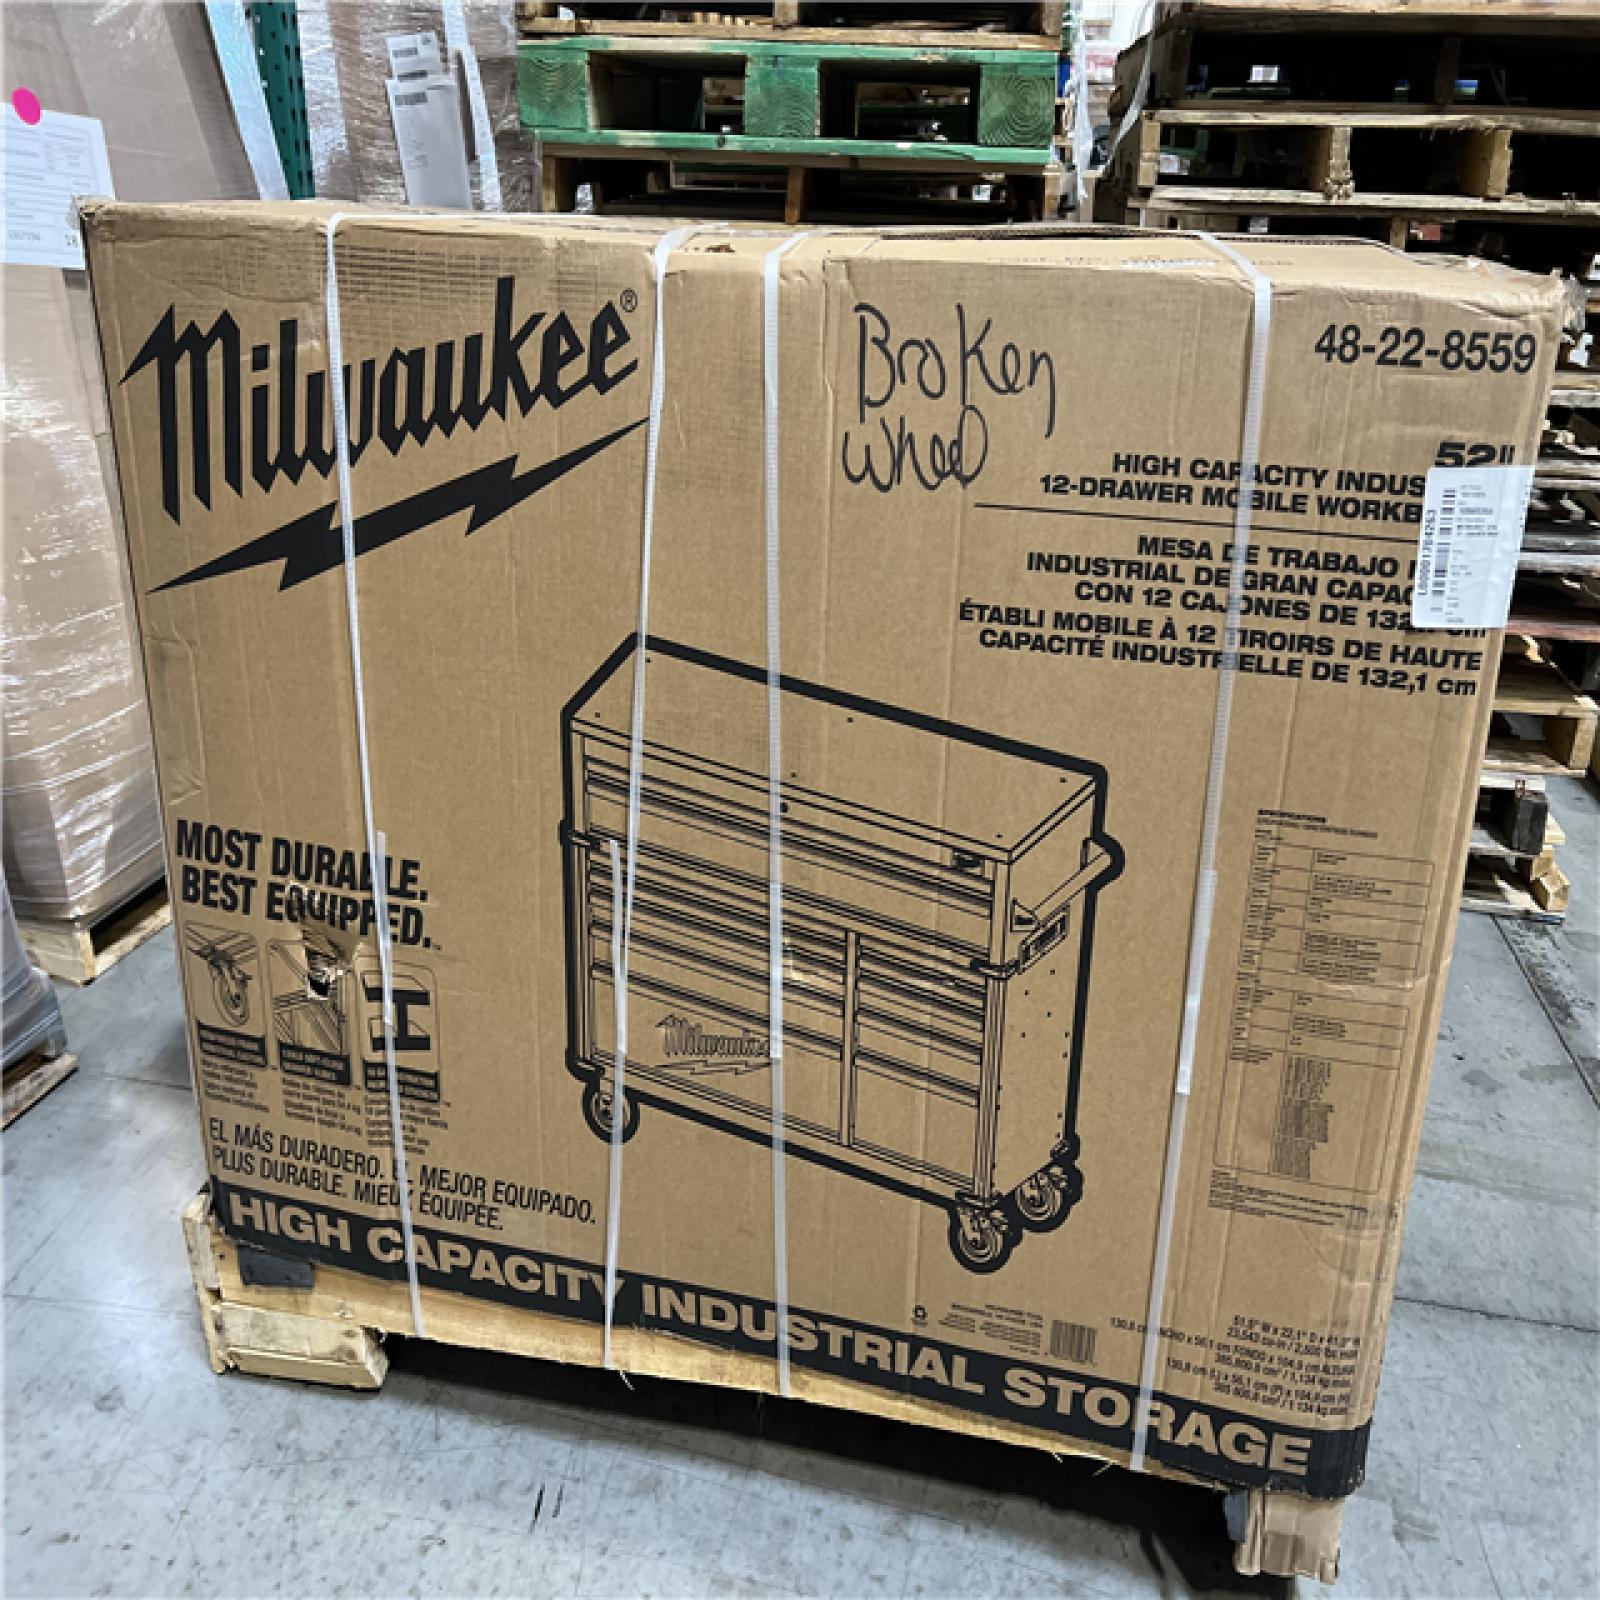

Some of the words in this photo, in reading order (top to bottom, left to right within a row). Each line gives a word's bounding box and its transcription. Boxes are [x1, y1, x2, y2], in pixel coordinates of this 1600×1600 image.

[1314, 323, 1537, 374] 48-22-8559
[119, 276, 638, 525] Milwaukee
[1040, 474, 1194, 506] 12-DRAWER
[1317, 495, 1424, 524] WORKB
[1113, 452, 1179, 479] HIGH
[1336, 470, 1425, 497] INDUS
[1027, 551, 1185, 586] INDUSTRIAL
[1194, 566, 1230, 588] DE
[1242, 569, 1318, 597] GRAN
[1137, 535, 1213, 562] MESA
[1267, 547, 1399, 578] TRABAJO
[959, 597, 1045, 628] ÉTABLI
[1053, 610, 1152, 638] MOBILE
[1160, 614, 1179, 640] À
[1187, 624, 1216, 645] 12
[1343, 640, 1382, 662] DE
[1389, 643, 1483, 671] HAUTE
[1075, 580, 1135, 605] CON
[1143, 586, 1172, 608] 12
[1320, 604, 1358, 627] DE
[1367, 609, 1436, 633] 132
[979, 628, 1104, 658] CAPACITÉ
[1311, 658, 1350, 684] DE
[1358, 666, 1428, 696] 132,1
[1437, 677, 1477, 696] cm
[177, 819, 263, 872] MOST
[271, 836, 429, 902] DURABLE.
[182, 864, 258, 917] BEST
[267, 882, 431, 949] EQUIPPED.
[209, 1117, 229, 1143] EL
[234, 1122, 274, 1154] MÁS
[279, 1134, 384, 1179] DURADERO.
[420, 1164, 487, 1204] MEJOR
[492, 1178, 596, 1224] EQUIPADO.
[213, 1144, 255, 1176] PLUS
[259, 1156, 347, 1198] DURABLE.
[229, 1192, 352, 1253] HIGH
[366, 1226, 626, 1309] CAPACITY
[642, 1283, 988, 1396] INDUSTRIAL
[1004, 1367, 1312, 1477] STORAGE
